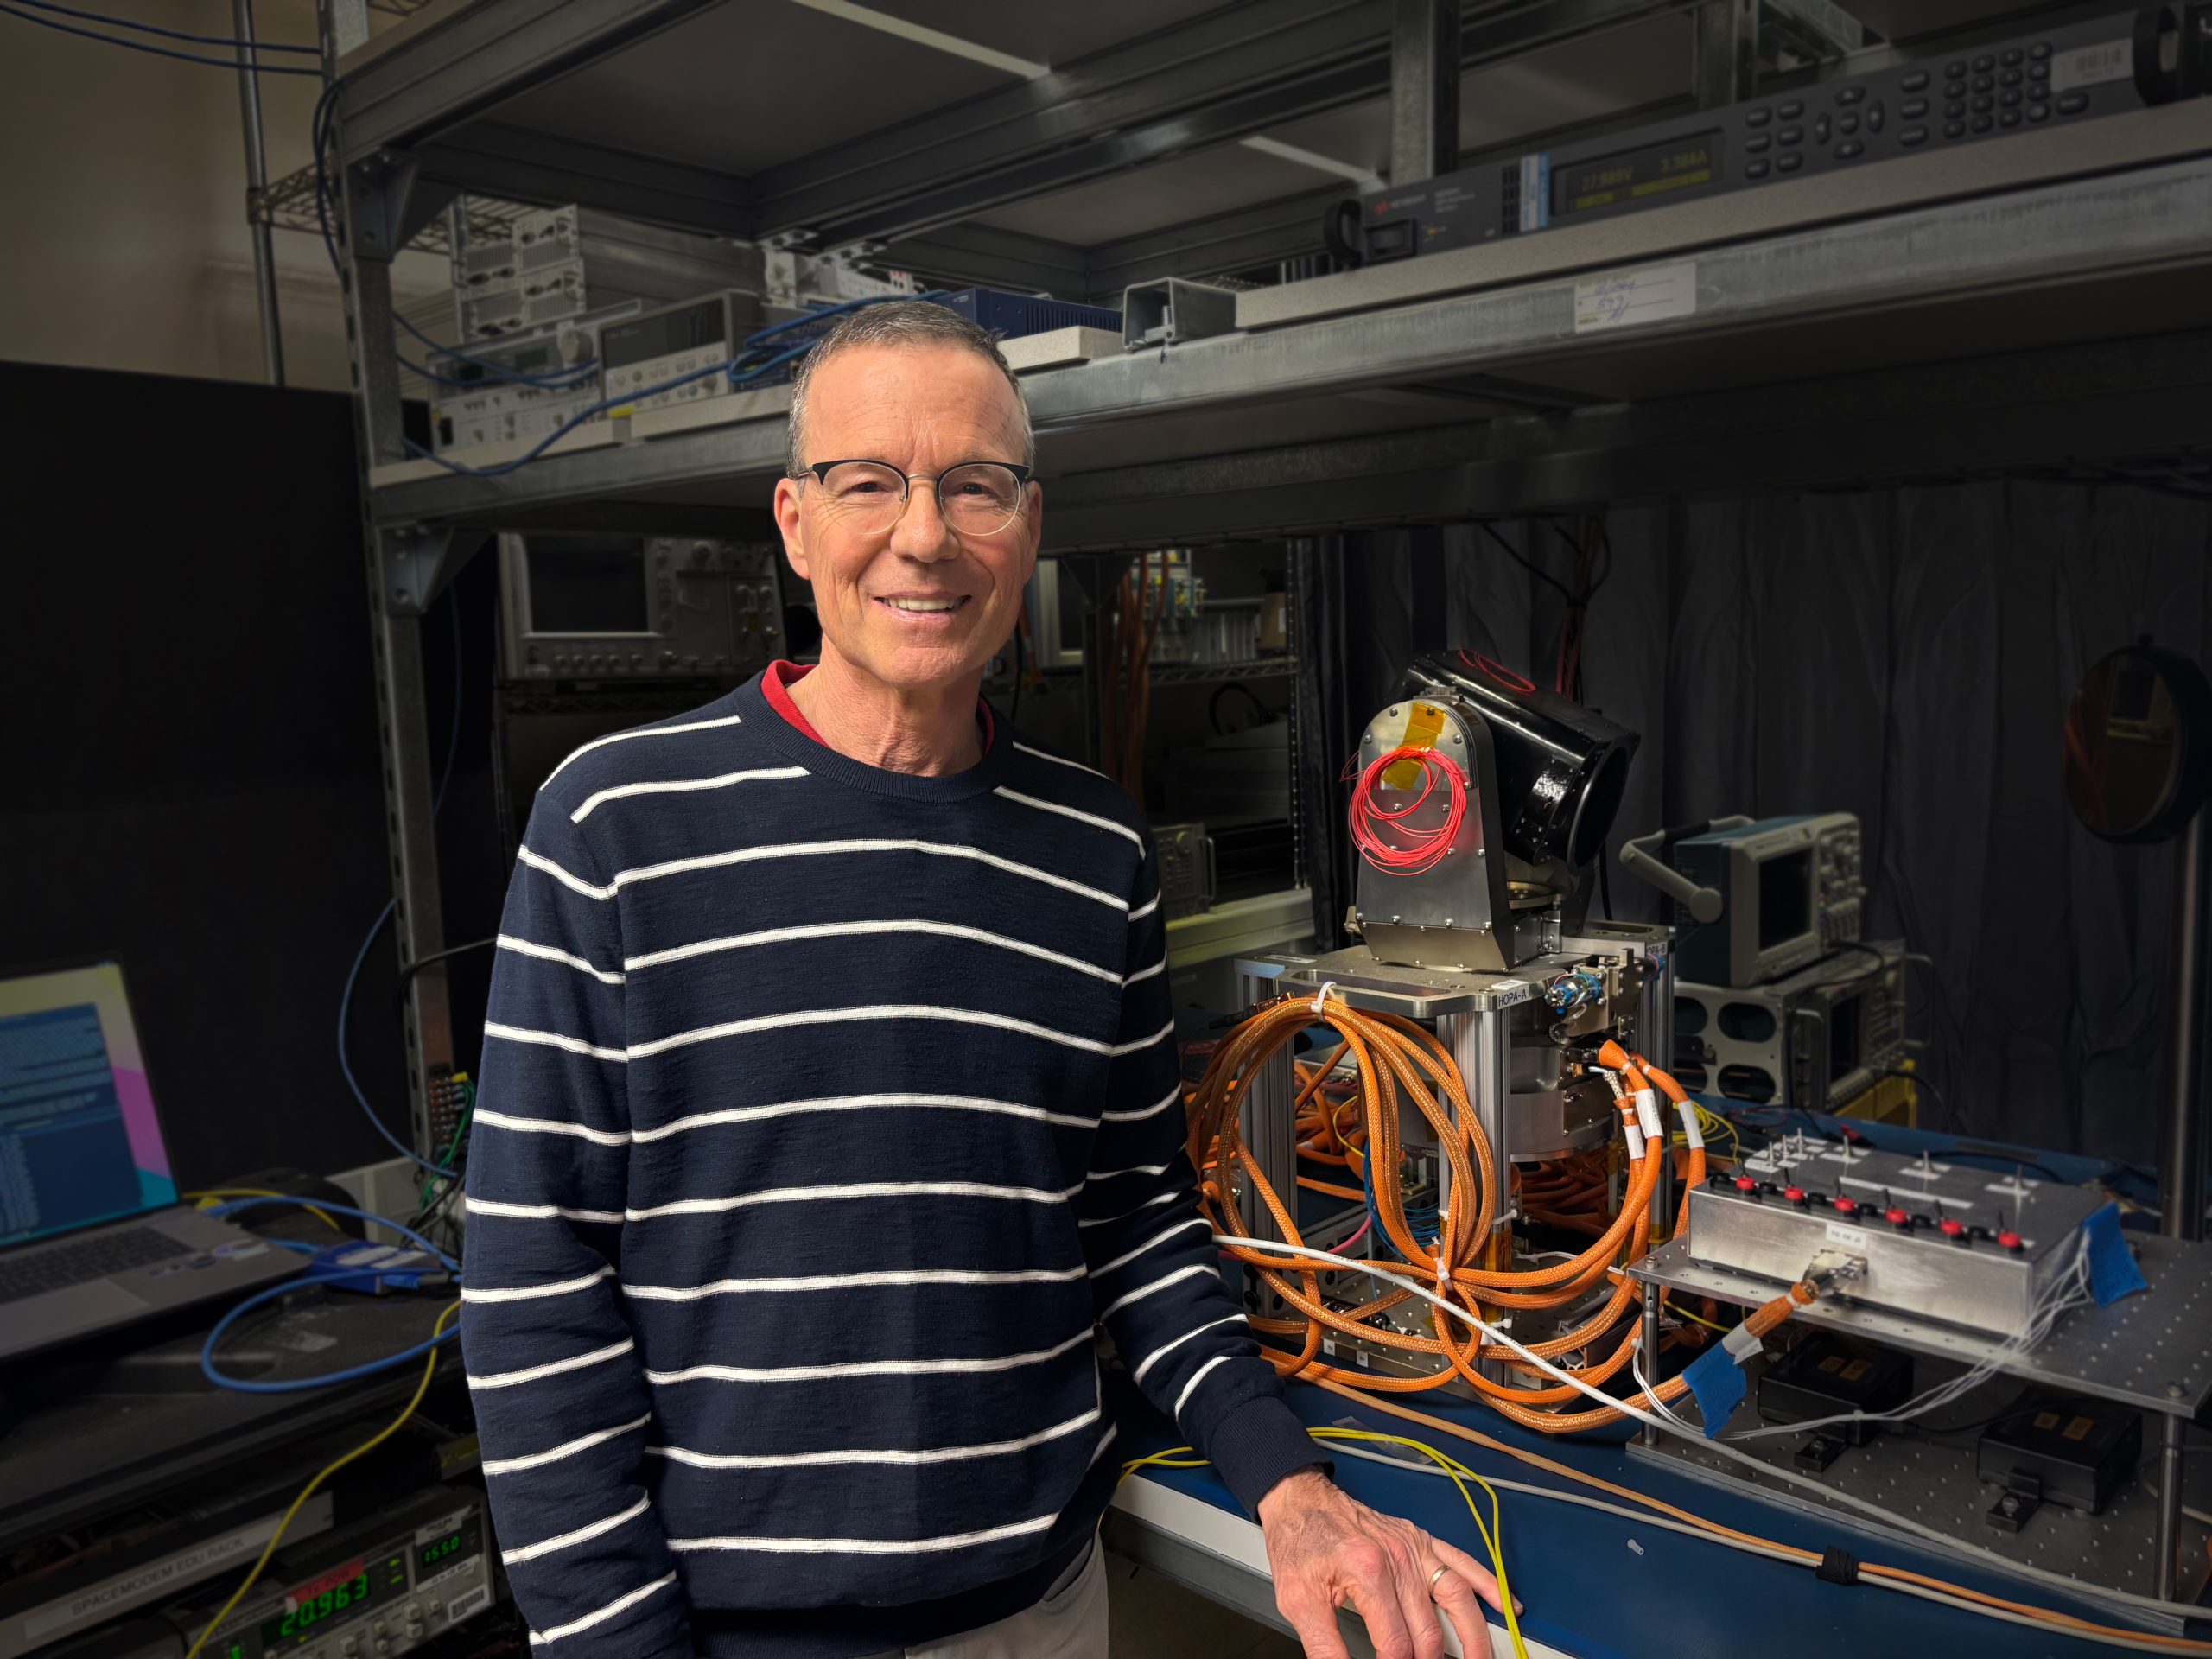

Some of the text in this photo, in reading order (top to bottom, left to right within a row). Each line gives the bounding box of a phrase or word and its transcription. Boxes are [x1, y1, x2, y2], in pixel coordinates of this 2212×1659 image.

[1498, 991, 1527, 1007] HOPA-A
[423, 1535, 461, 1563] 1550
[72, 1538, 244, 1615] SPACEMODEM EDU RACK
